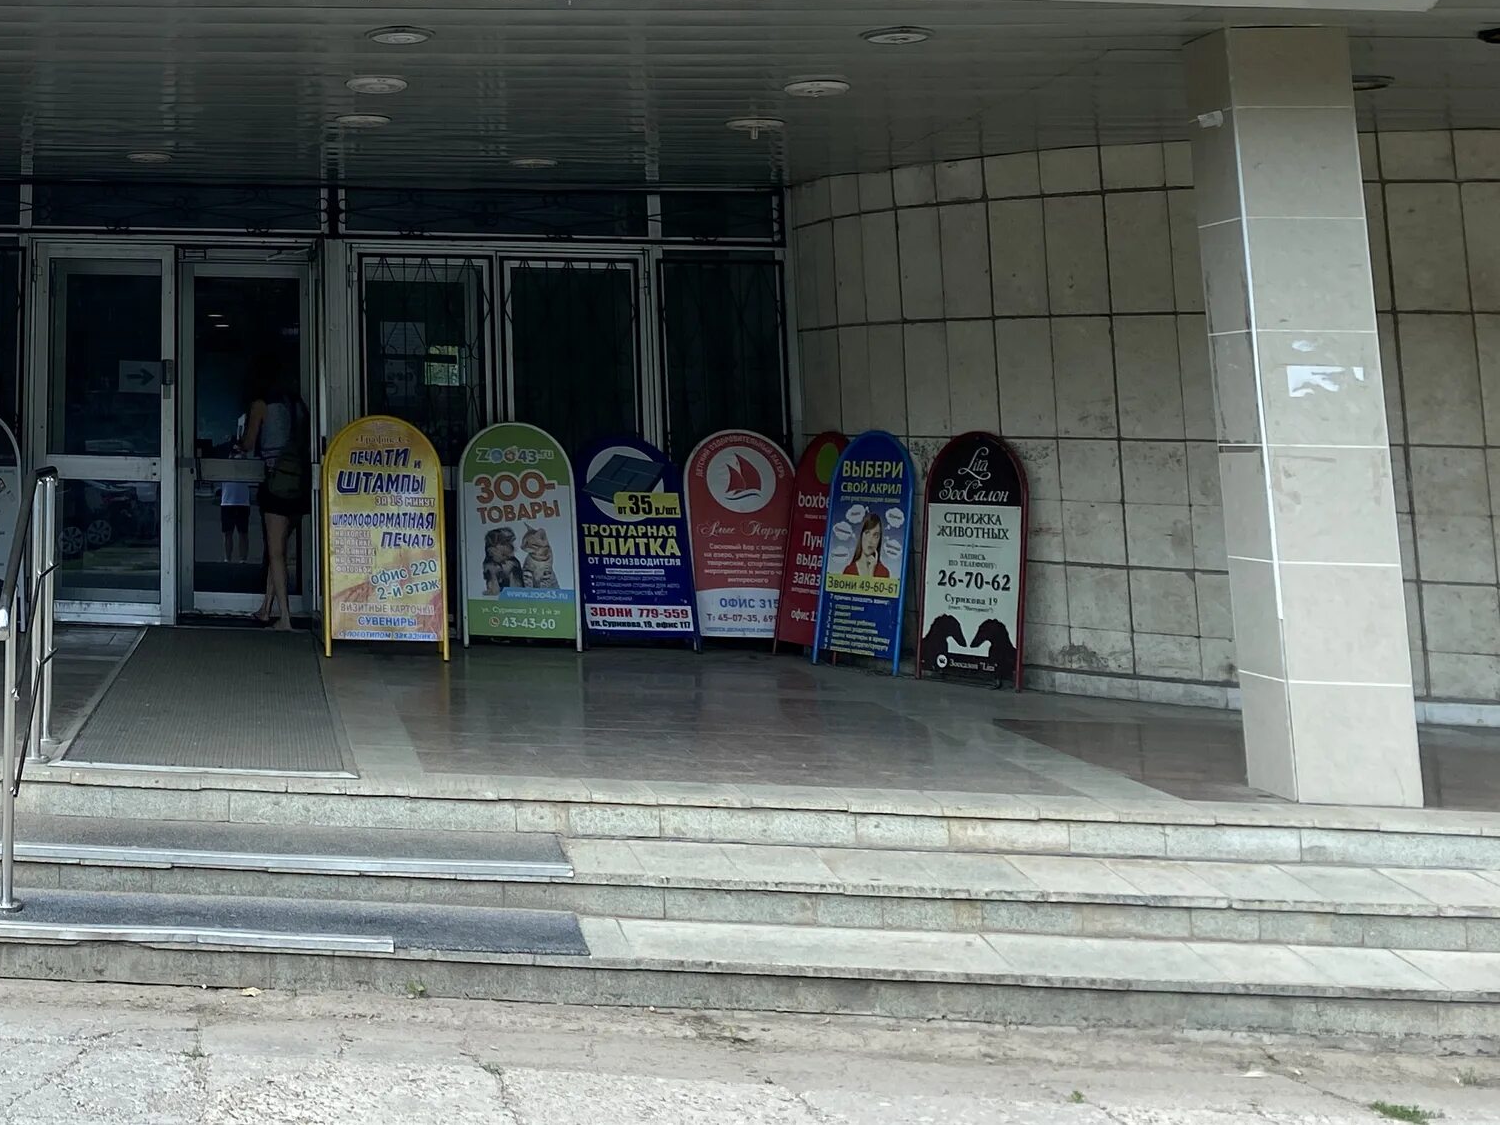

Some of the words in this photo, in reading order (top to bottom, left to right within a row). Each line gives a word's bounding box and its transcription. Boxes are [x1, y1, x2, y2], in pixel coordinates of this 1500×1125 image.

[350, 448, 409, 467] ПЕЧАТИ
[958, 447, 991, 481] Lita
[842, 461, 903, 479] ВЫБЕРИ
[337, 471, 425, 494] ШТАМПЫ
[841, 481, 868, 493] СВОЙ
[870, 483, 902, 495] АКРИЛ
[939, 479, 1009, 502] ЗооСалон
[477, 500, 561, 524] ТОВАРЫ
[628, 495, 653, 516] 35
[332, 512, 436, 530] ШИРОКОФОРМАТНАЯ
[944, 512, 1002, 526] СТРИЖКА
[582, 524, 677, 537] ТРОТУАРНАЯ
[937, 525, 1010, 540] ЖИВОТНЫХ
[381, 531, 435, 547] ПЕЧАТЬ
[585, 537, 681, 556] ПЛИТКА
[803, 531, 825, 551] Пун
[588, 557, 599, 565] ОТ
[603, 558, 681, 567] ПРОИЗВОДИТЕЛЯ
[796, 553, 823, 570] выда
[960, 553, 986, 561] ЗАПИСЬ
[371, 568, 408, 584] офис
[411, 560, 437, 576] 220
[792, 572, 821, 587] заказ
[828, 577, 857, 590] Звони
[938, 570, 1011, 591] 26-70-62
[377, 584, 402, 600] 2-й
[405, 579, 439, 594] этаж
[720, 598, 756, 609] ОФИС
[945, 593, 986, 605] Сурикова
[989, 597, 998, 606] 19
[340, 604, 389, 613] ВИЗИТНЫЕ
[390, 605, 435, 614] КАРТОЧКИ
[590, 607, 632, 618] ЗВОНИ
[638, 609, 689, 619] 779-559
[358, 617, 417, 626] СУВЕНИРЫ
[502, 617, 556, 629] 43-43-60
[656, 621, 678, 629] офис
